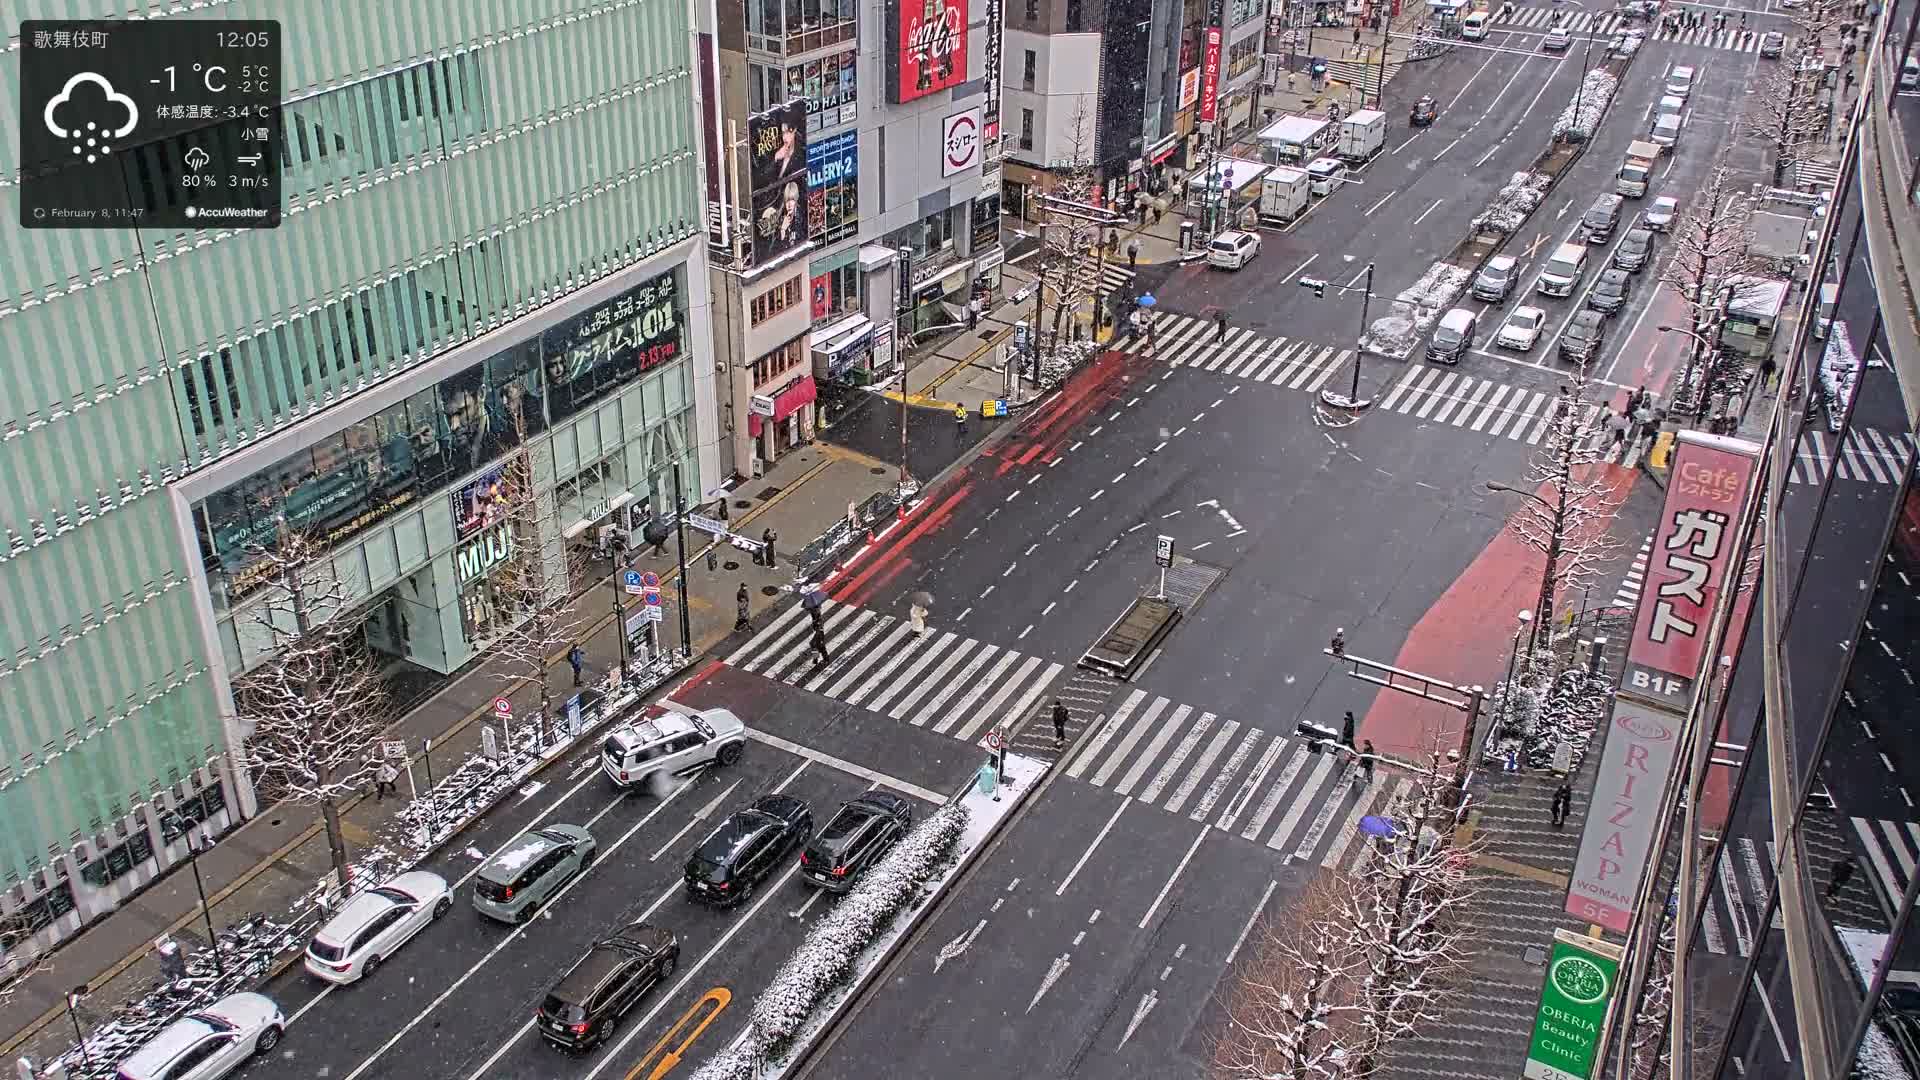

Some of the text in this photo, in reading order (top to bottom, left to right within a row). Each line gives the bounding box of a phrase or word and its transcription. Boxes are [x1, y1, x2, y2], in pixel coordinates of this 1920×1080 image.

[1204, 46, 1219, 111] バーガーキング
[947, 134, 978, 153] スシロー
[708, 200, 721, 234] MUJI
[1681, 462, 1737, 489] Café
[458, 525, 514, 582] MUJI
[1649, 508, 1729, 644] ガスト
[1631, 670, 1681, 696] B1F
[1597, 743, 1649, 881] RIZAP
[1576, 879, 1632, 905] WOMAN
[1541, 1005, 1596, 1033] OBERIA
[1541, 1020, 1589, 1047] Beauty
[1541, 1039, 1582, 1062] Clinic
